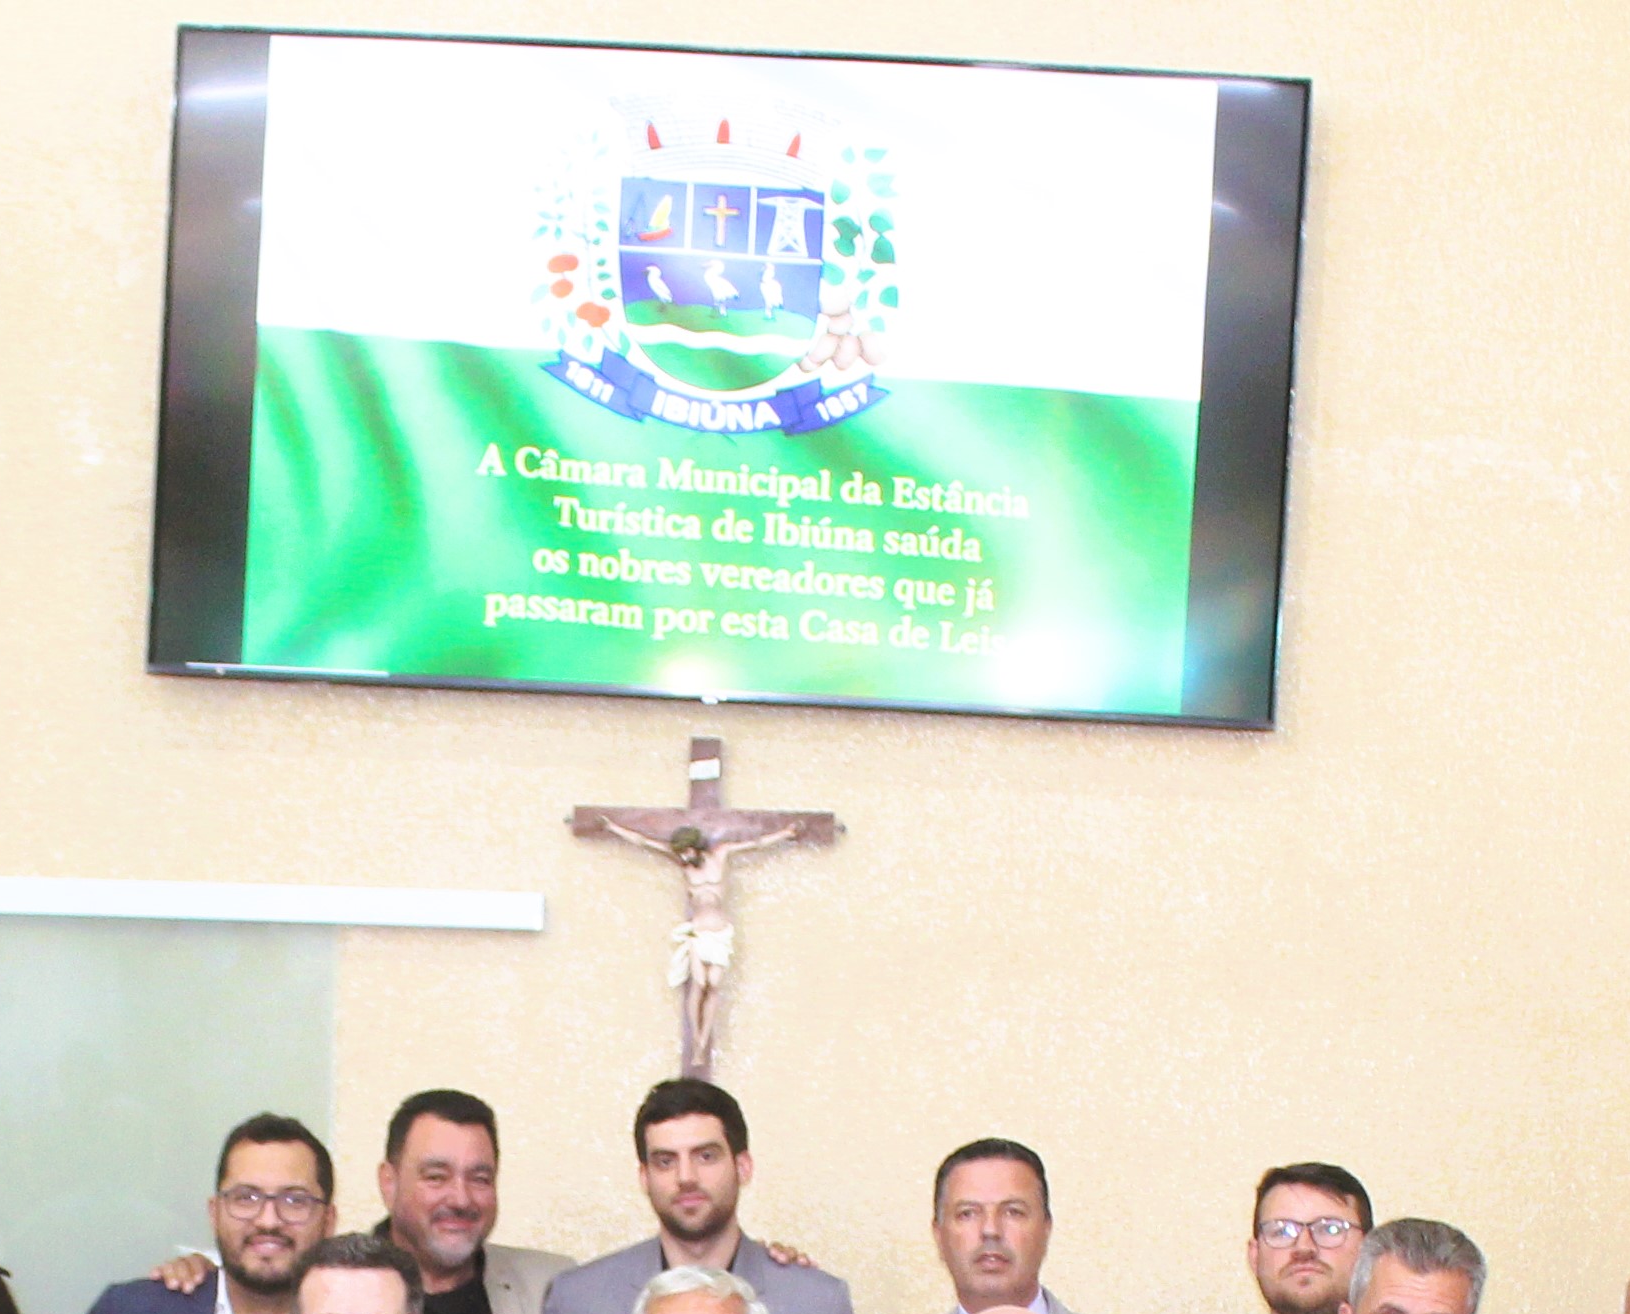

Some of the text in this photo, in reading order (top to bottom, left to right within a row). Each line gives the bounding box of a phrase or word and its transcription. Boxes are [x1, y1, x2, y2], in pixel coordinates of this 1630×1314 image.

[476, 442, 1031, 519] A Câmara Municipal da Estância
[553, 495, 983, 562] Turística de Ibiúna saúda
[532, 547, 994, 618] os nobres vereadores que já
[483, 592, 644, 630] passaram
[650, 606, 716, 641] por
[720, 608, 791, 640] esta
[799, 609, 879, 646] Casa
[888, 615, 931, 649] de
